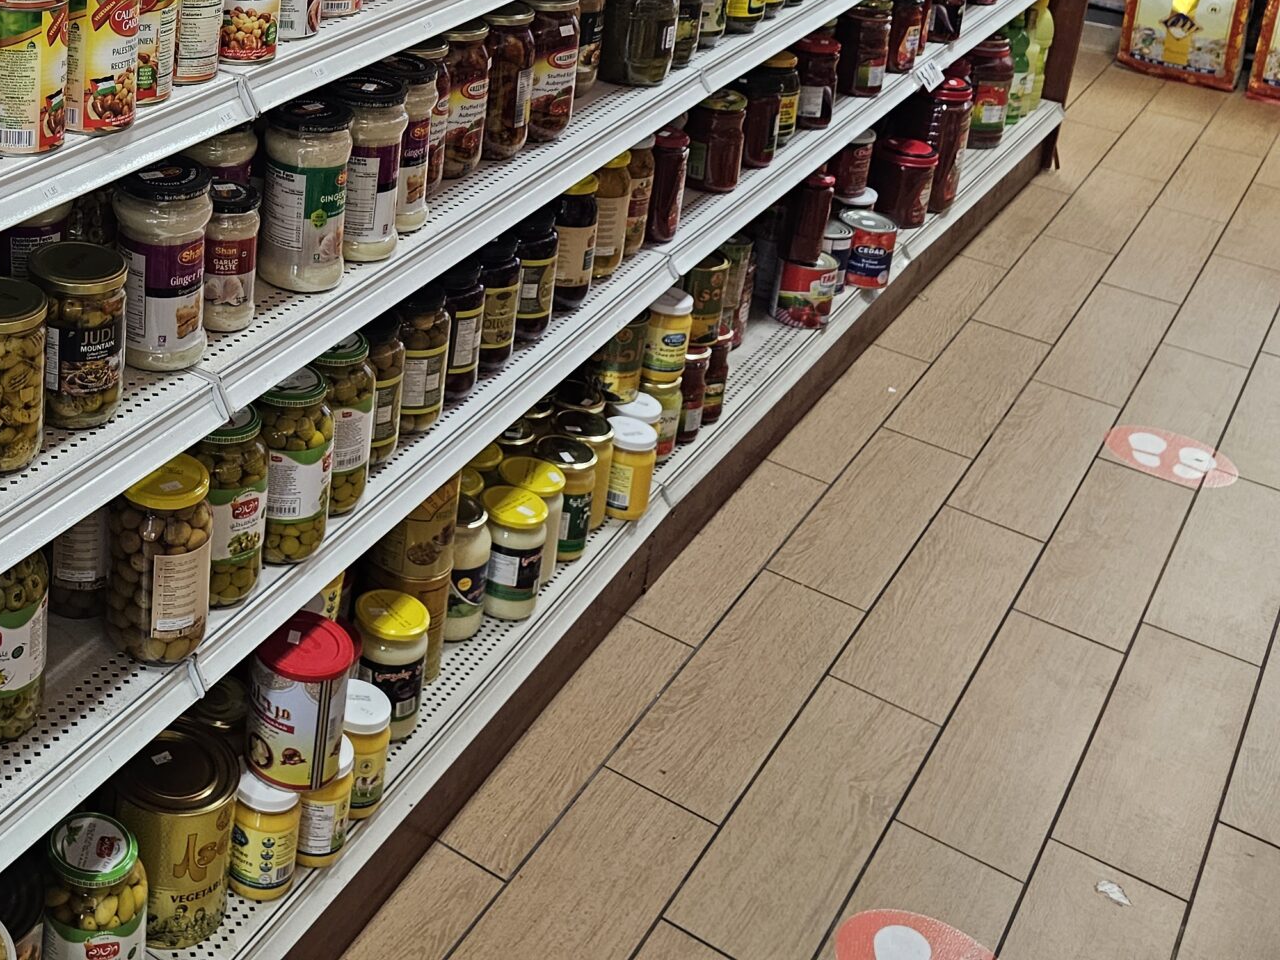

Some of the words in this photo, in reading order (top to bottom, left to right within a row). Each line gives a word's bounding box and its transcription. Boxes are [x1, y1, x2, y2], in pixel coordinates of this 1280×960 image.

[215, 246, 237, 256] Shan
[857, 246, 885, 256] CEDAR
[81, 339, 115, 353] MOUNTAIN
